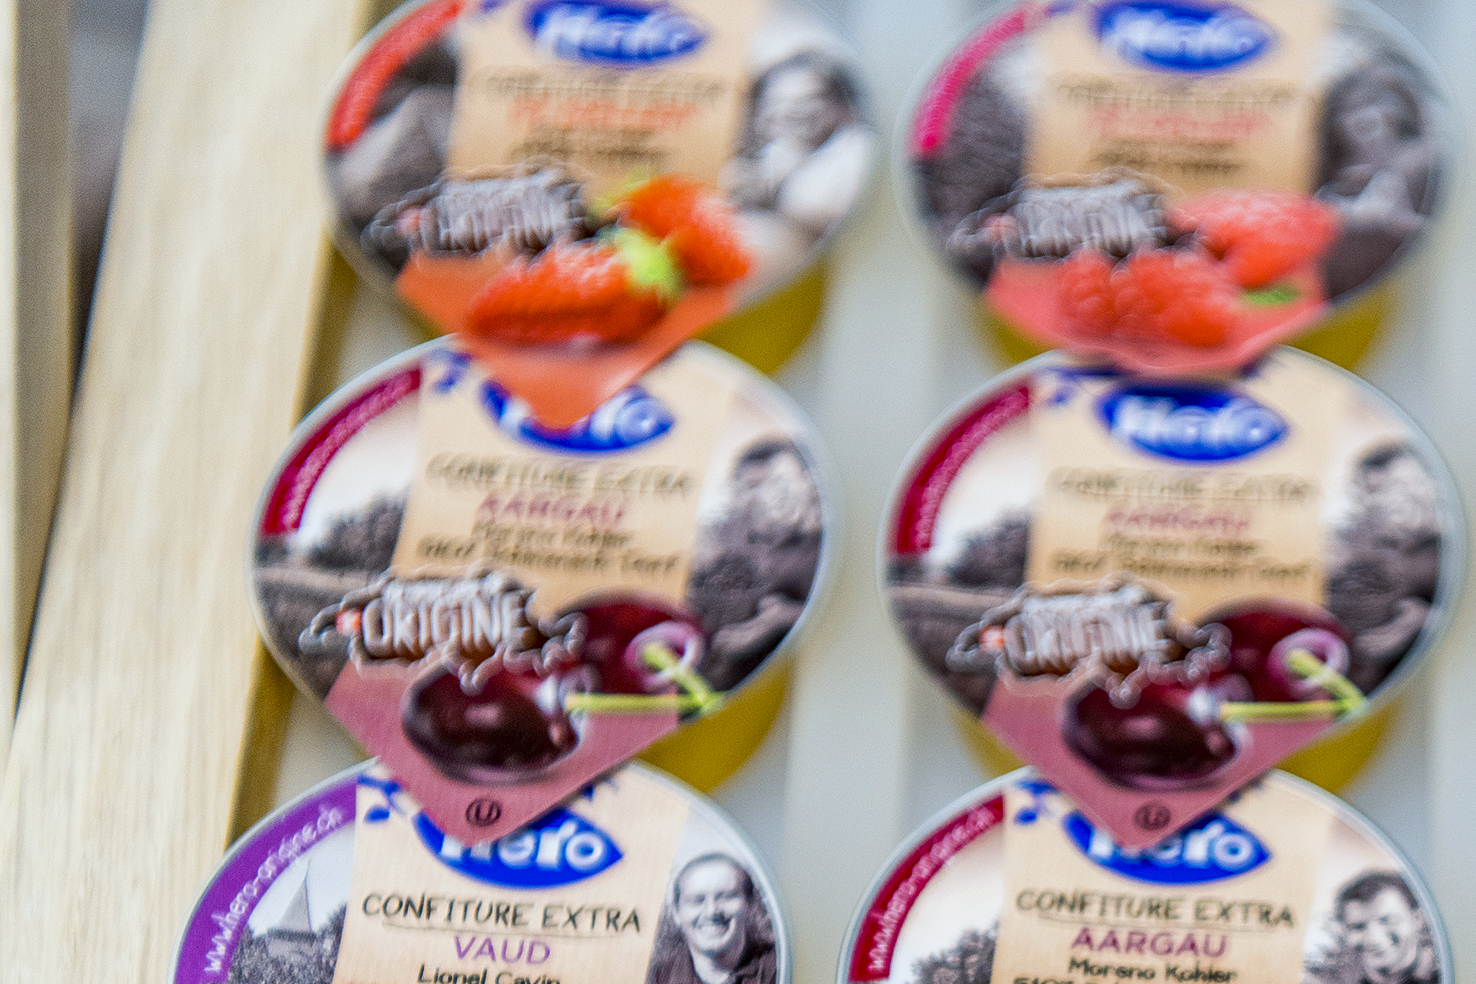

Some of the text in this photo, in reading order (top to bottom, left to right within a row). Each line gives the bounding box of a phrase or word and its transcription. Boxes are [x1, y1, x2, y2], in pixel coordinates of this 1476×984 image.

[362, 892, 641, 932] CONFITURE EXTRA
[1016, 890, 1295, 928] CONFITURE EXTRA
[453, 937, 550, 965] VAUD
[1071, 928, 1228, 957] AARGAU
[1069, 959, 1238, 984] Moreno Kohler
